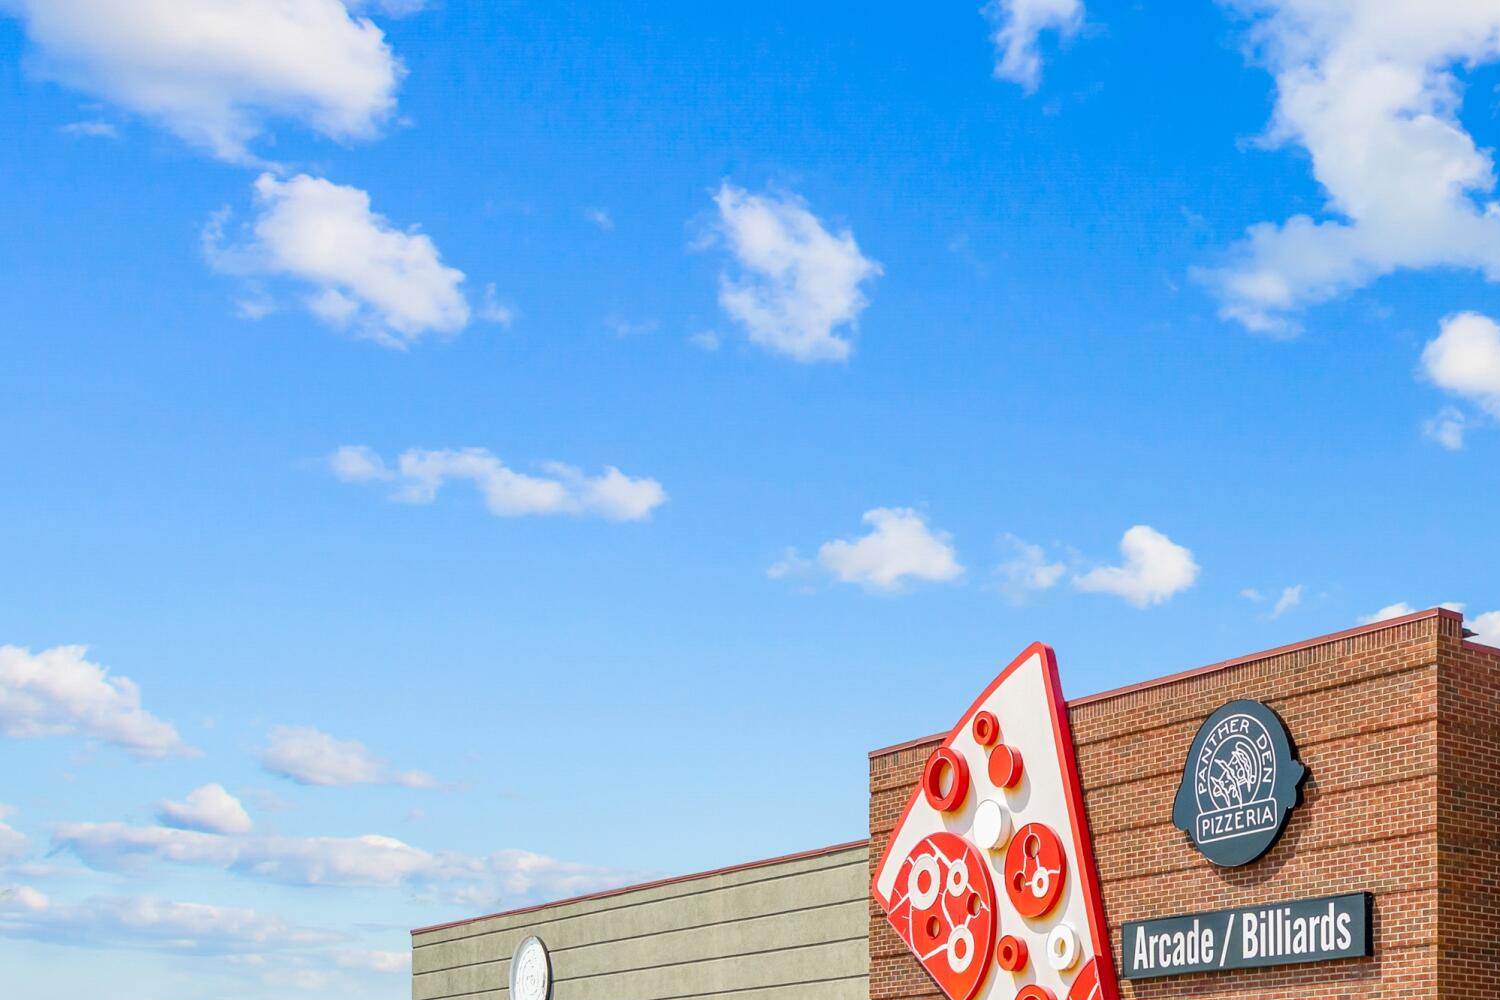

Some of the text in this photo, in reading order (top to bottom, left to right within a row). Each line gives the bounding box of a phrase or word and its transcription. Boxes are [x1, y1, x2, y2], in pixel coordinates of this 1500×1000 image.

[1198, 718, 1273, 795] PANTHER DEN
[1201, 805, 1274, 837] PIZZERIA
[1132, 901, 1352, 970] Arcade / Billiards
